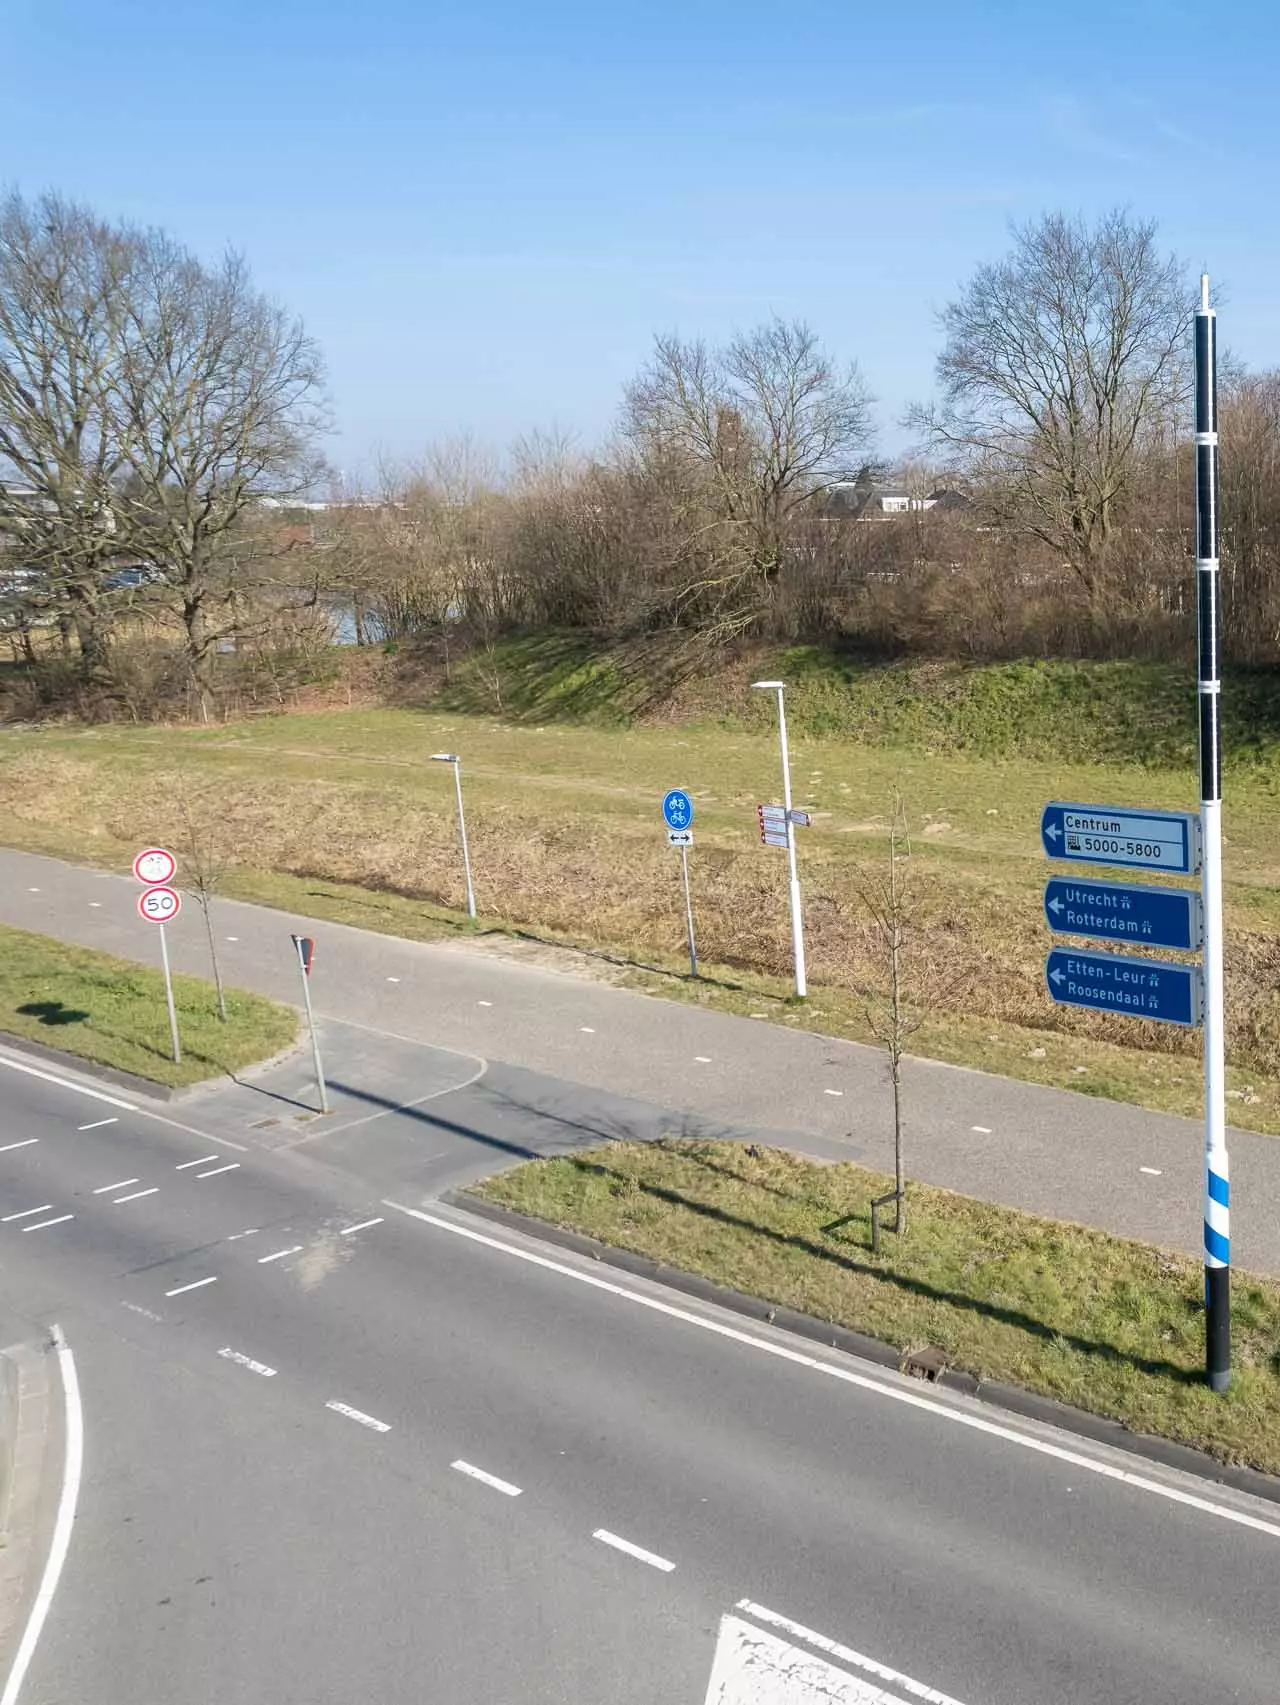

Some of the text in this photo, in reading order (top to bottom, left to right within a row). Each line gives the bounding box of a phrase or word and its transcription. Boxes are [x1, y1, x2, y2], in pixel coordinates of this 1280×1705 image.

[1065, 816, 1121, 833] Centrum
[1084, 838, 1161, 858] 5000-5800
[147, 896, 173, 912] 50
[1065, 888, 1118, 908] Utrecht
[1067, 911, 1138, 932] Rotterdam
[1067, 960, 1146, 985] Etten-Leur
[1068, 981, 1145, 1006] Roosendaal
